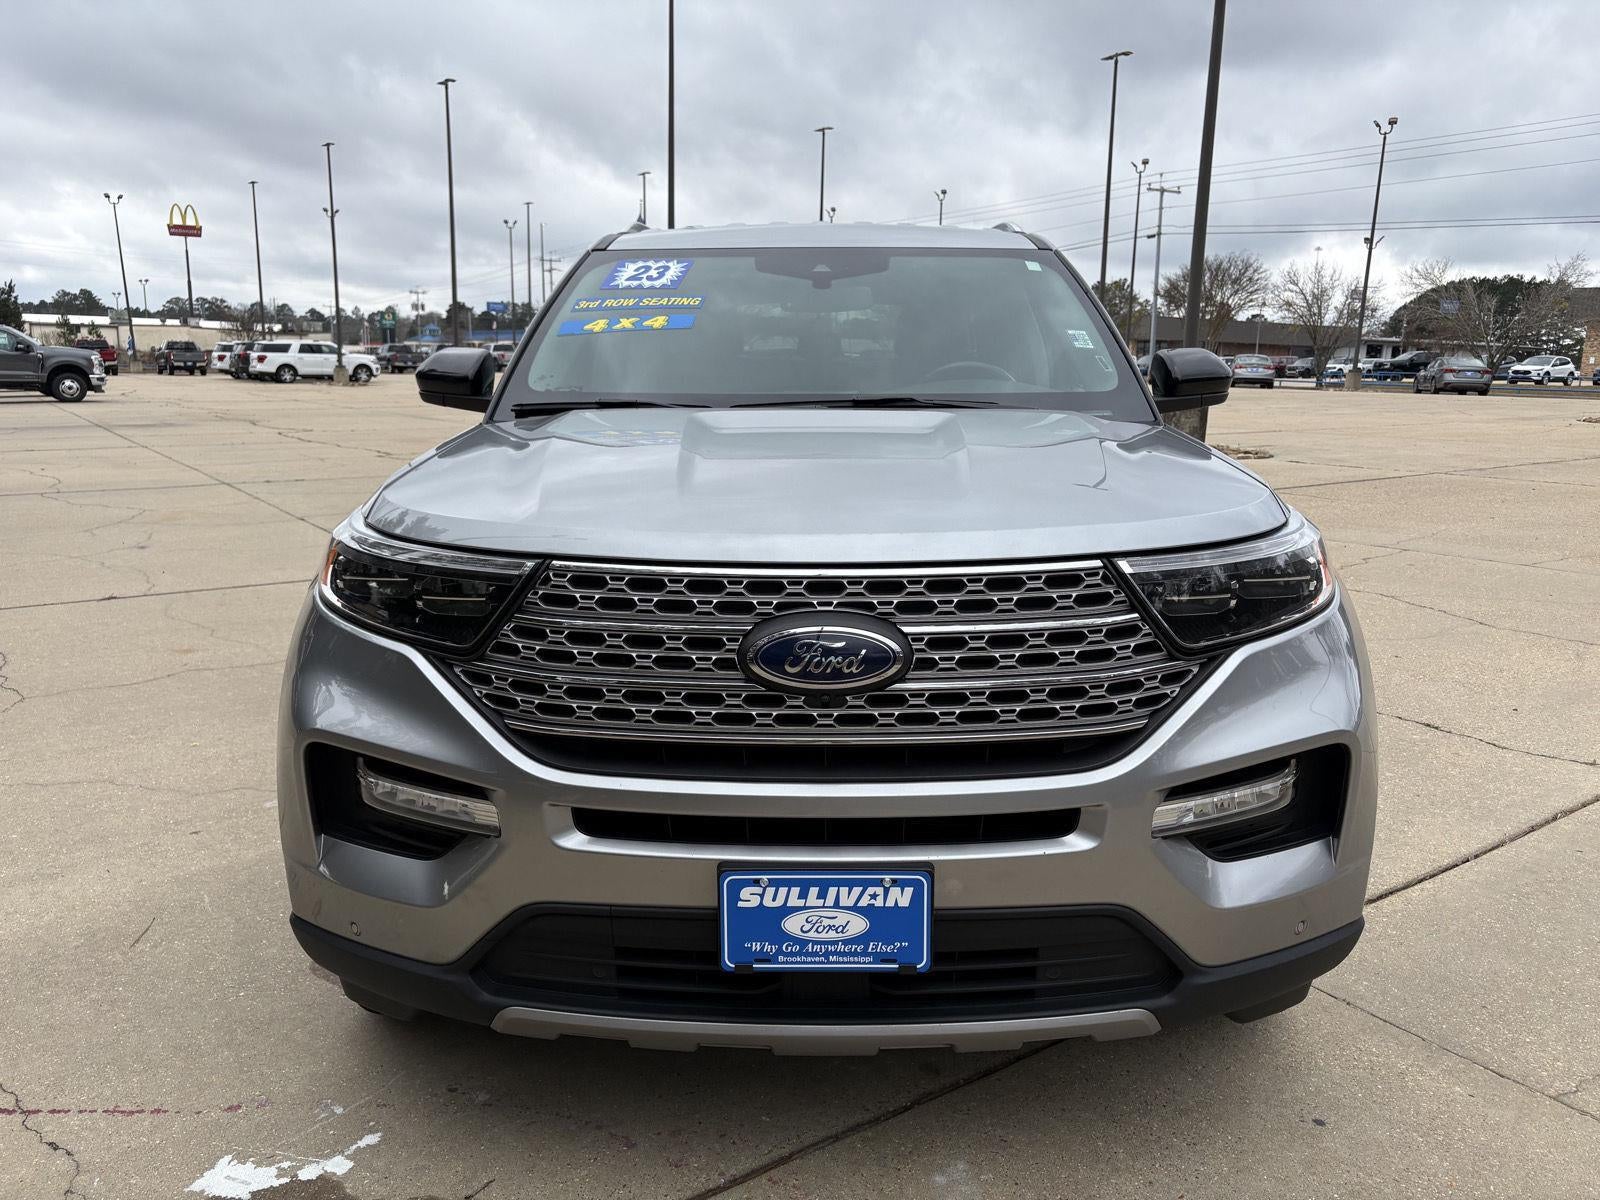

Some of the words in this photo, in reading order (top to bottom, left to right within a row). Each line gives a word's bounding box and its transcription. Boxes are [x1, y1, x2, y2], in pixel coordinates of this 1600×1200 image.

[624, 265, 671, 282] 23
[575, 299, 601, 309] 3rd
[602, 297, 638, 308] ROW
[640, 297, 702, 306] SEATING
[784, 640, 866, 674] Ford
[737, 886, 914, 908] SULLIVAN
[800, 914, 850, 935] Ford
[782, 942, 800, 952] Go
[804, 942, 864, 955] Anywhere
[778, 956, 827, 964] Brookhaven,
[829, 955, 873, 964] Mississippi
